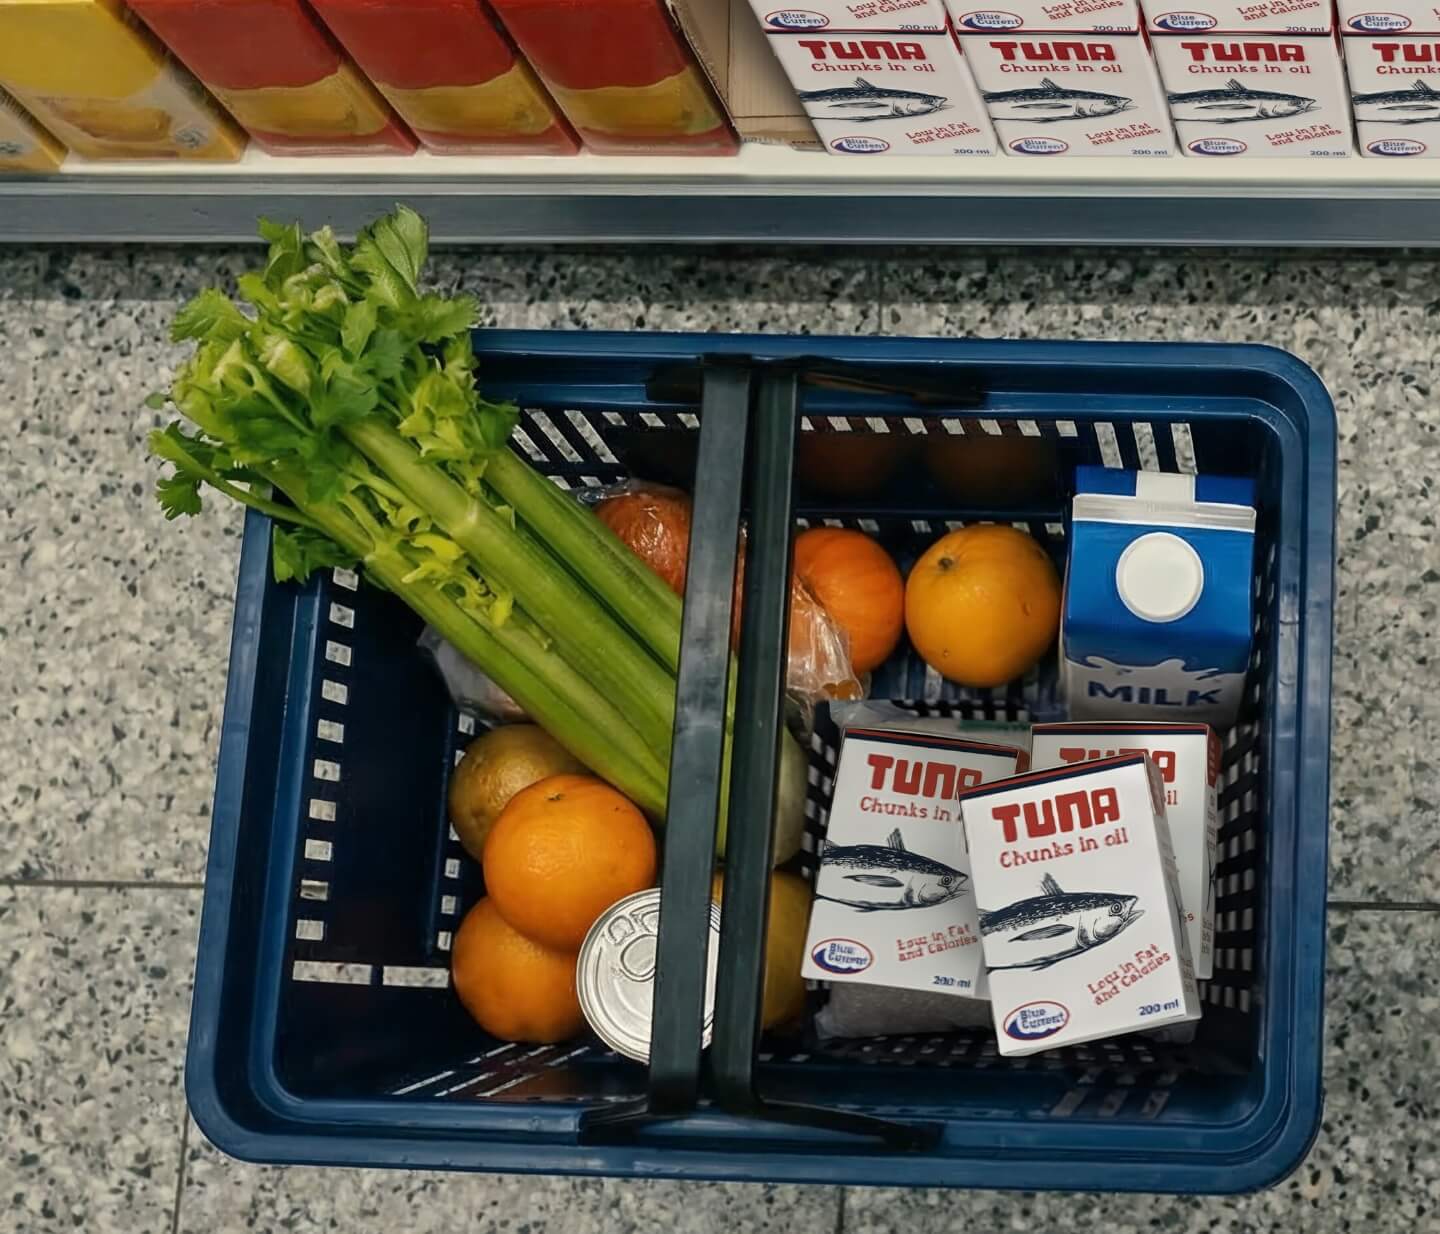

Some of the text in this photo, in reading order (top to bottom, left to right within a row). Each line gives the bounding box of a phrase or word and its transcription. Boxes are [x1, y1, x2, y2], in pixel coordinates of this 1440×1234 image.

[854, 9, 878, 19] and
[1048, 1, 1124, 20] and Calories
[1243, 2, 1320, 21] and Calories
[798, 41, 926, 60] TUNA
[990, 42, 1116, 60] TUNA
[1181, 42, 1305, 61] TUNA
[811, 63, 882, 71] Chunks
[913, 64, 935, 72] oil
[1000, 64, 1122, 73] Chunks in oil
[1188, 65, 1311, 74] Chunks in oil
[906, 129, 933, 139] Low
[949, 122, 969, 130] Fat
[912, 127, 981, 145] and Calories
[1086, 131, 1115, 140] Low
[1129, 123, 1151, 131] Fat
[1091, 128, 1161, 145] and Calories
[1265, 132, 1294, 141] Low
[1310, 124, 1332, 132] Fat
[1271, 129, 1342, 146] and Calories
[1087, 681, 1222, 706] MILK
[859, 795, 929, 820] Chunks
[933, 806, 951, 822] in
[991, 787, 1120, 843] TUNA
[999, 828, 1129, 868] Chunks in oil
[947, 923, 970, 938] Fat
[898, 934, 979, 962] and Calories
[1087, 943, 1160, 994] Low in Fat
[1094, 987, 1120, 1005] and
[1121, 951, 1171, 987] Calories
[1020, 1007, 1047, 1020] Blue
[1138, 999, 1179, 1016] 200 ml
